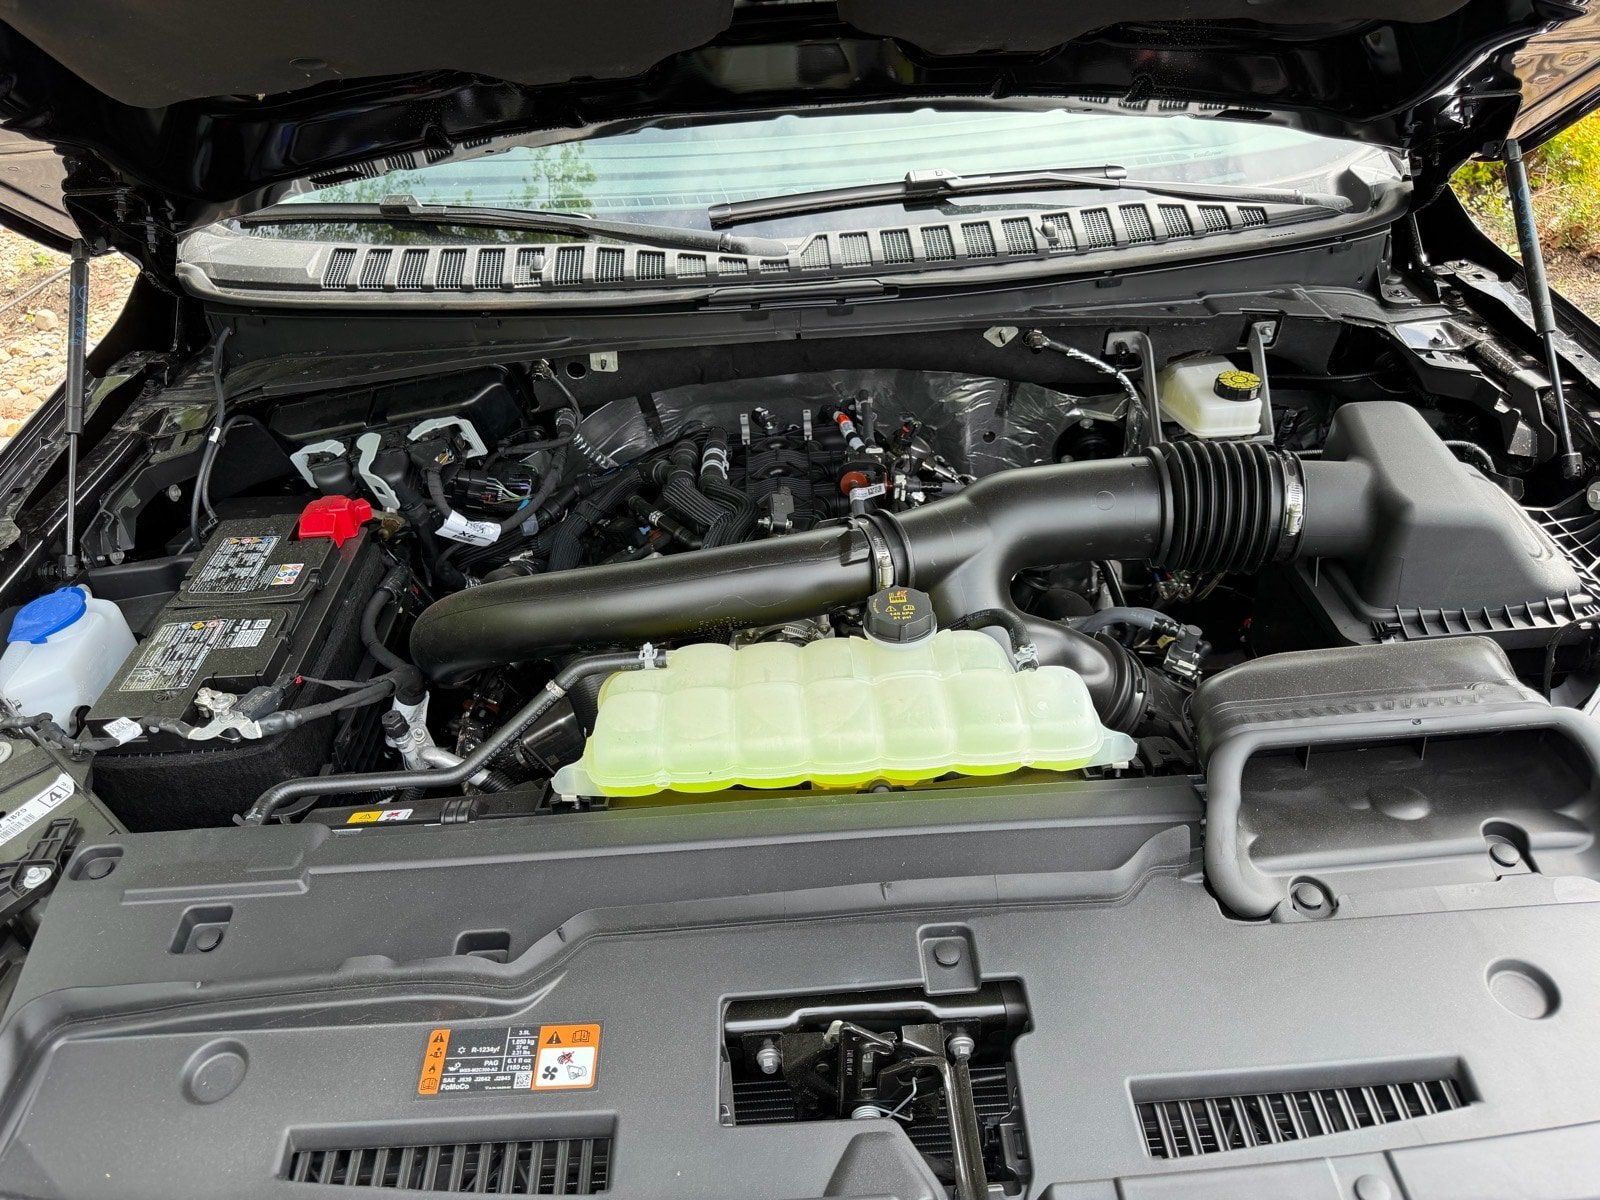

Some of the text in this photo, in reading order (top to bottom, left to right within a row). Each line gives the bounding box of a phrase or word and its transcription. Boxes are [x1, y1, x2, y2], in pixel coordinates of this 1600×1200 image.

[49, 791, 63, 802] 4
[527, 1038, 535, 1046] kg
[470, 1046, 501, 1054] R-1234yf
[440, 1083, 470, 1091] FoMoCo
